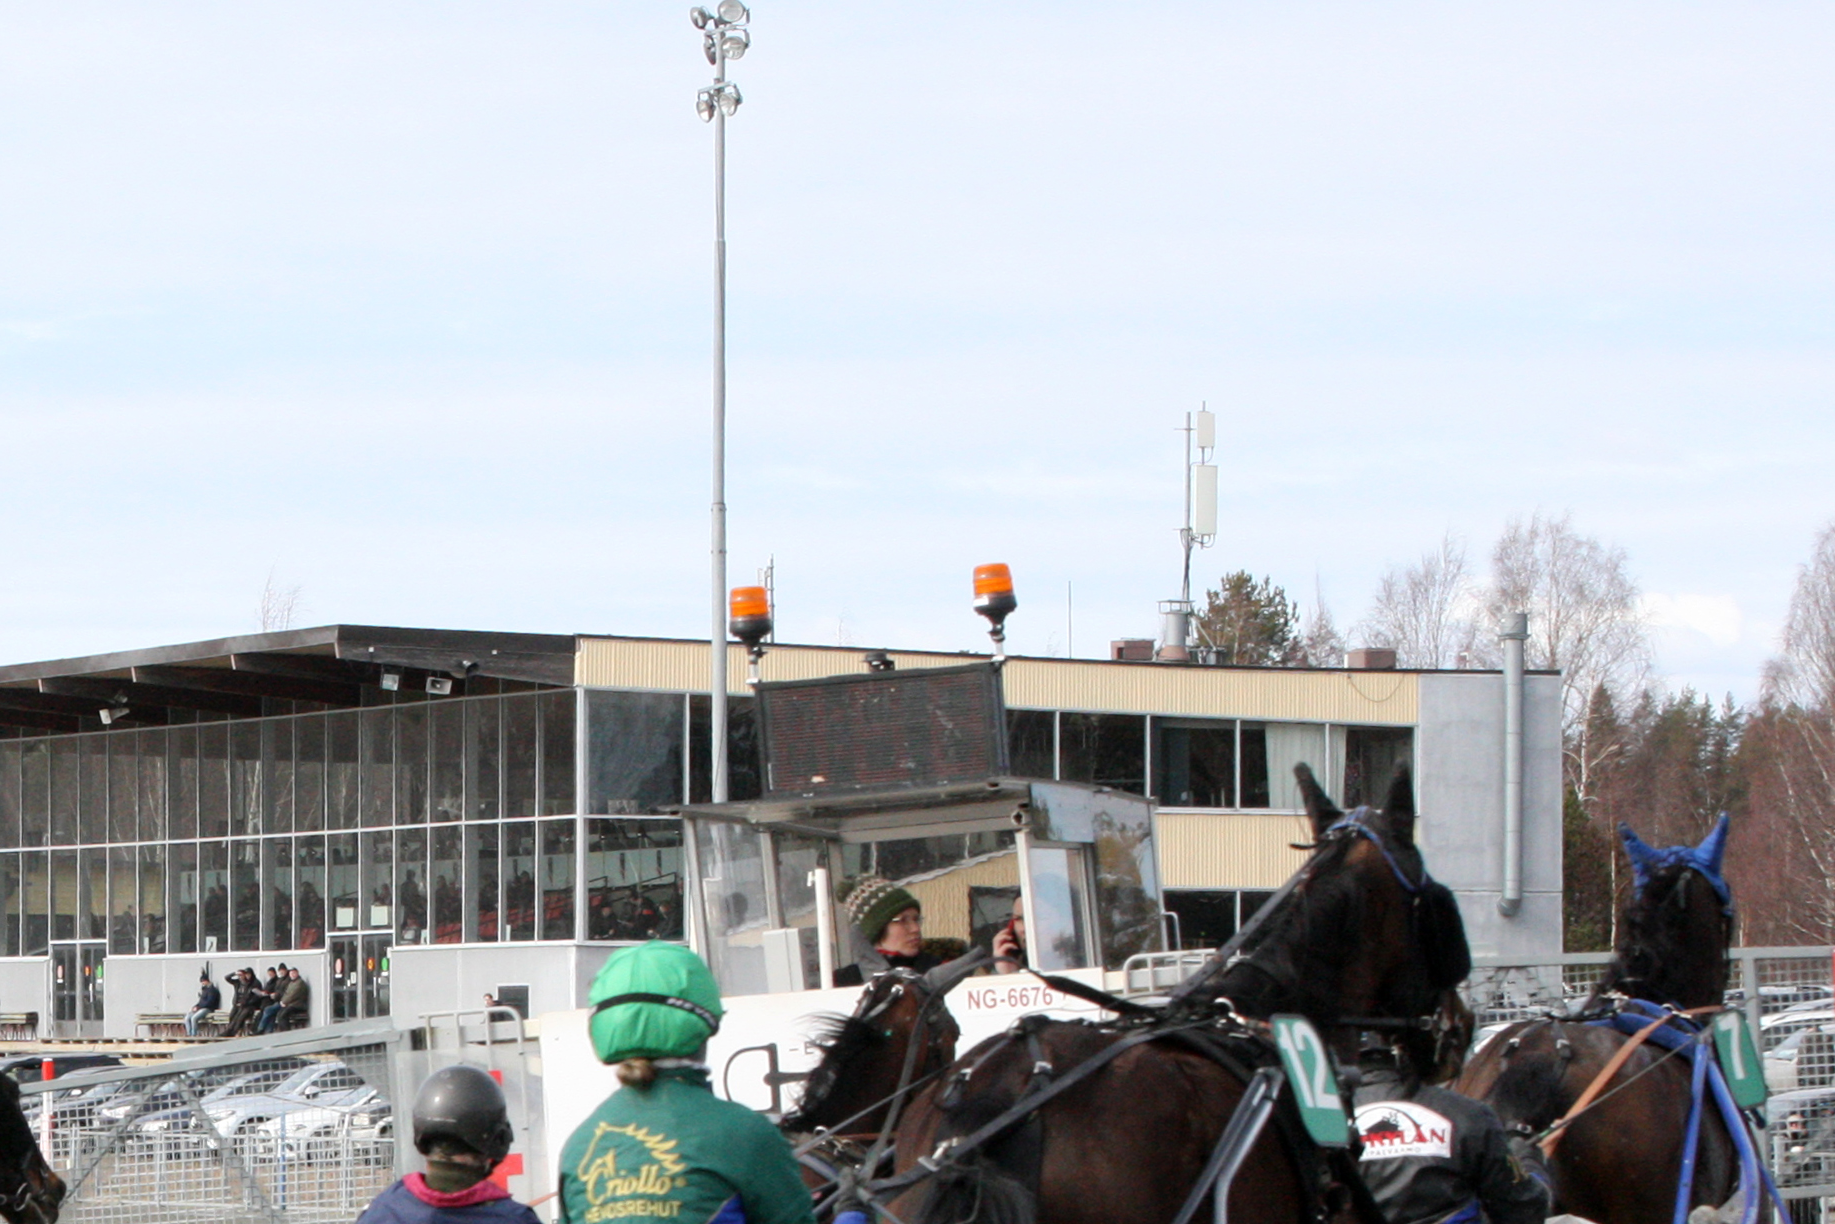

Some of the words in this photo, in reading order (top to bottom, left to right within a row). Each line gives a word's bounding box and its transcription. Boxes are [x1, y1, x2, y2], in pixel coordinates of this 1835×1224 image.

[967, 987, 1053, 1010] NG-6676
[1278, 1021, 1343, 1110] 12
[1716, 1012, 1746, 1081] 7
